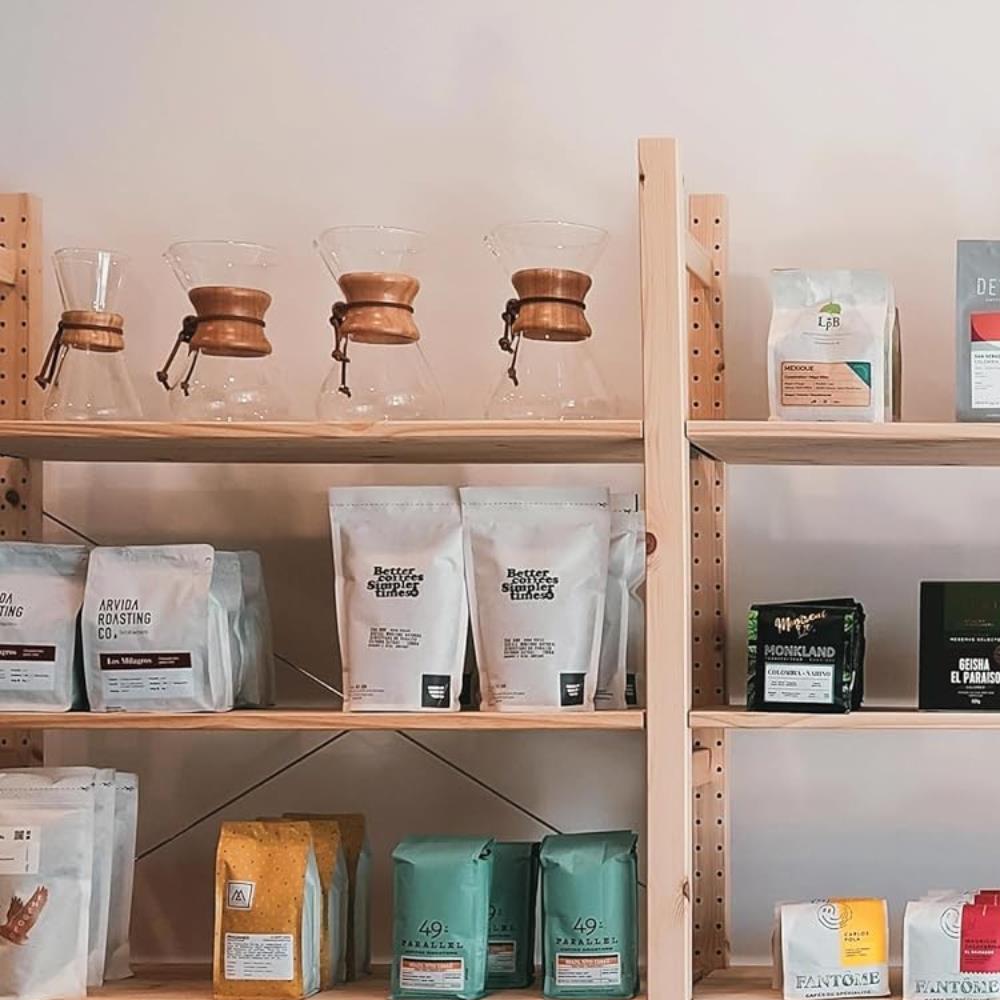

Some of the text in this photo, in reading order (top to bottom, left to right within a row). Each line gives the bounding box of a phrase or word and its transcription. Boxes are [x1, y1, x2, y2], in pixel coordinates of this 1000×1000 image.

[373, 566, 416, 576] Better
[507, 568, 550, 578] Better
[378, 574, 424, 582] coffees
[511, 576, 559, 585] coffees
[366, 580, 420, 590] Simpler
[501, 582, 555, 592] Simpler
[98, 599, 139, 611] ARVIDA
[98, 612, 152, 626] ROASTING
[98, 627, 118, 640] CO.
[764, 644, 836, 658] MONKLAND
[107, 657, 120, 665] Los
[121, 656, 152, 666] Milagros
[959, 658, 990, 671] GEISHA
[950, 670, 1000, 685] EL PARAISO
[402, 939, 464, 949] PARALLEL
[555, 937, 619, 945] PARALLEL
